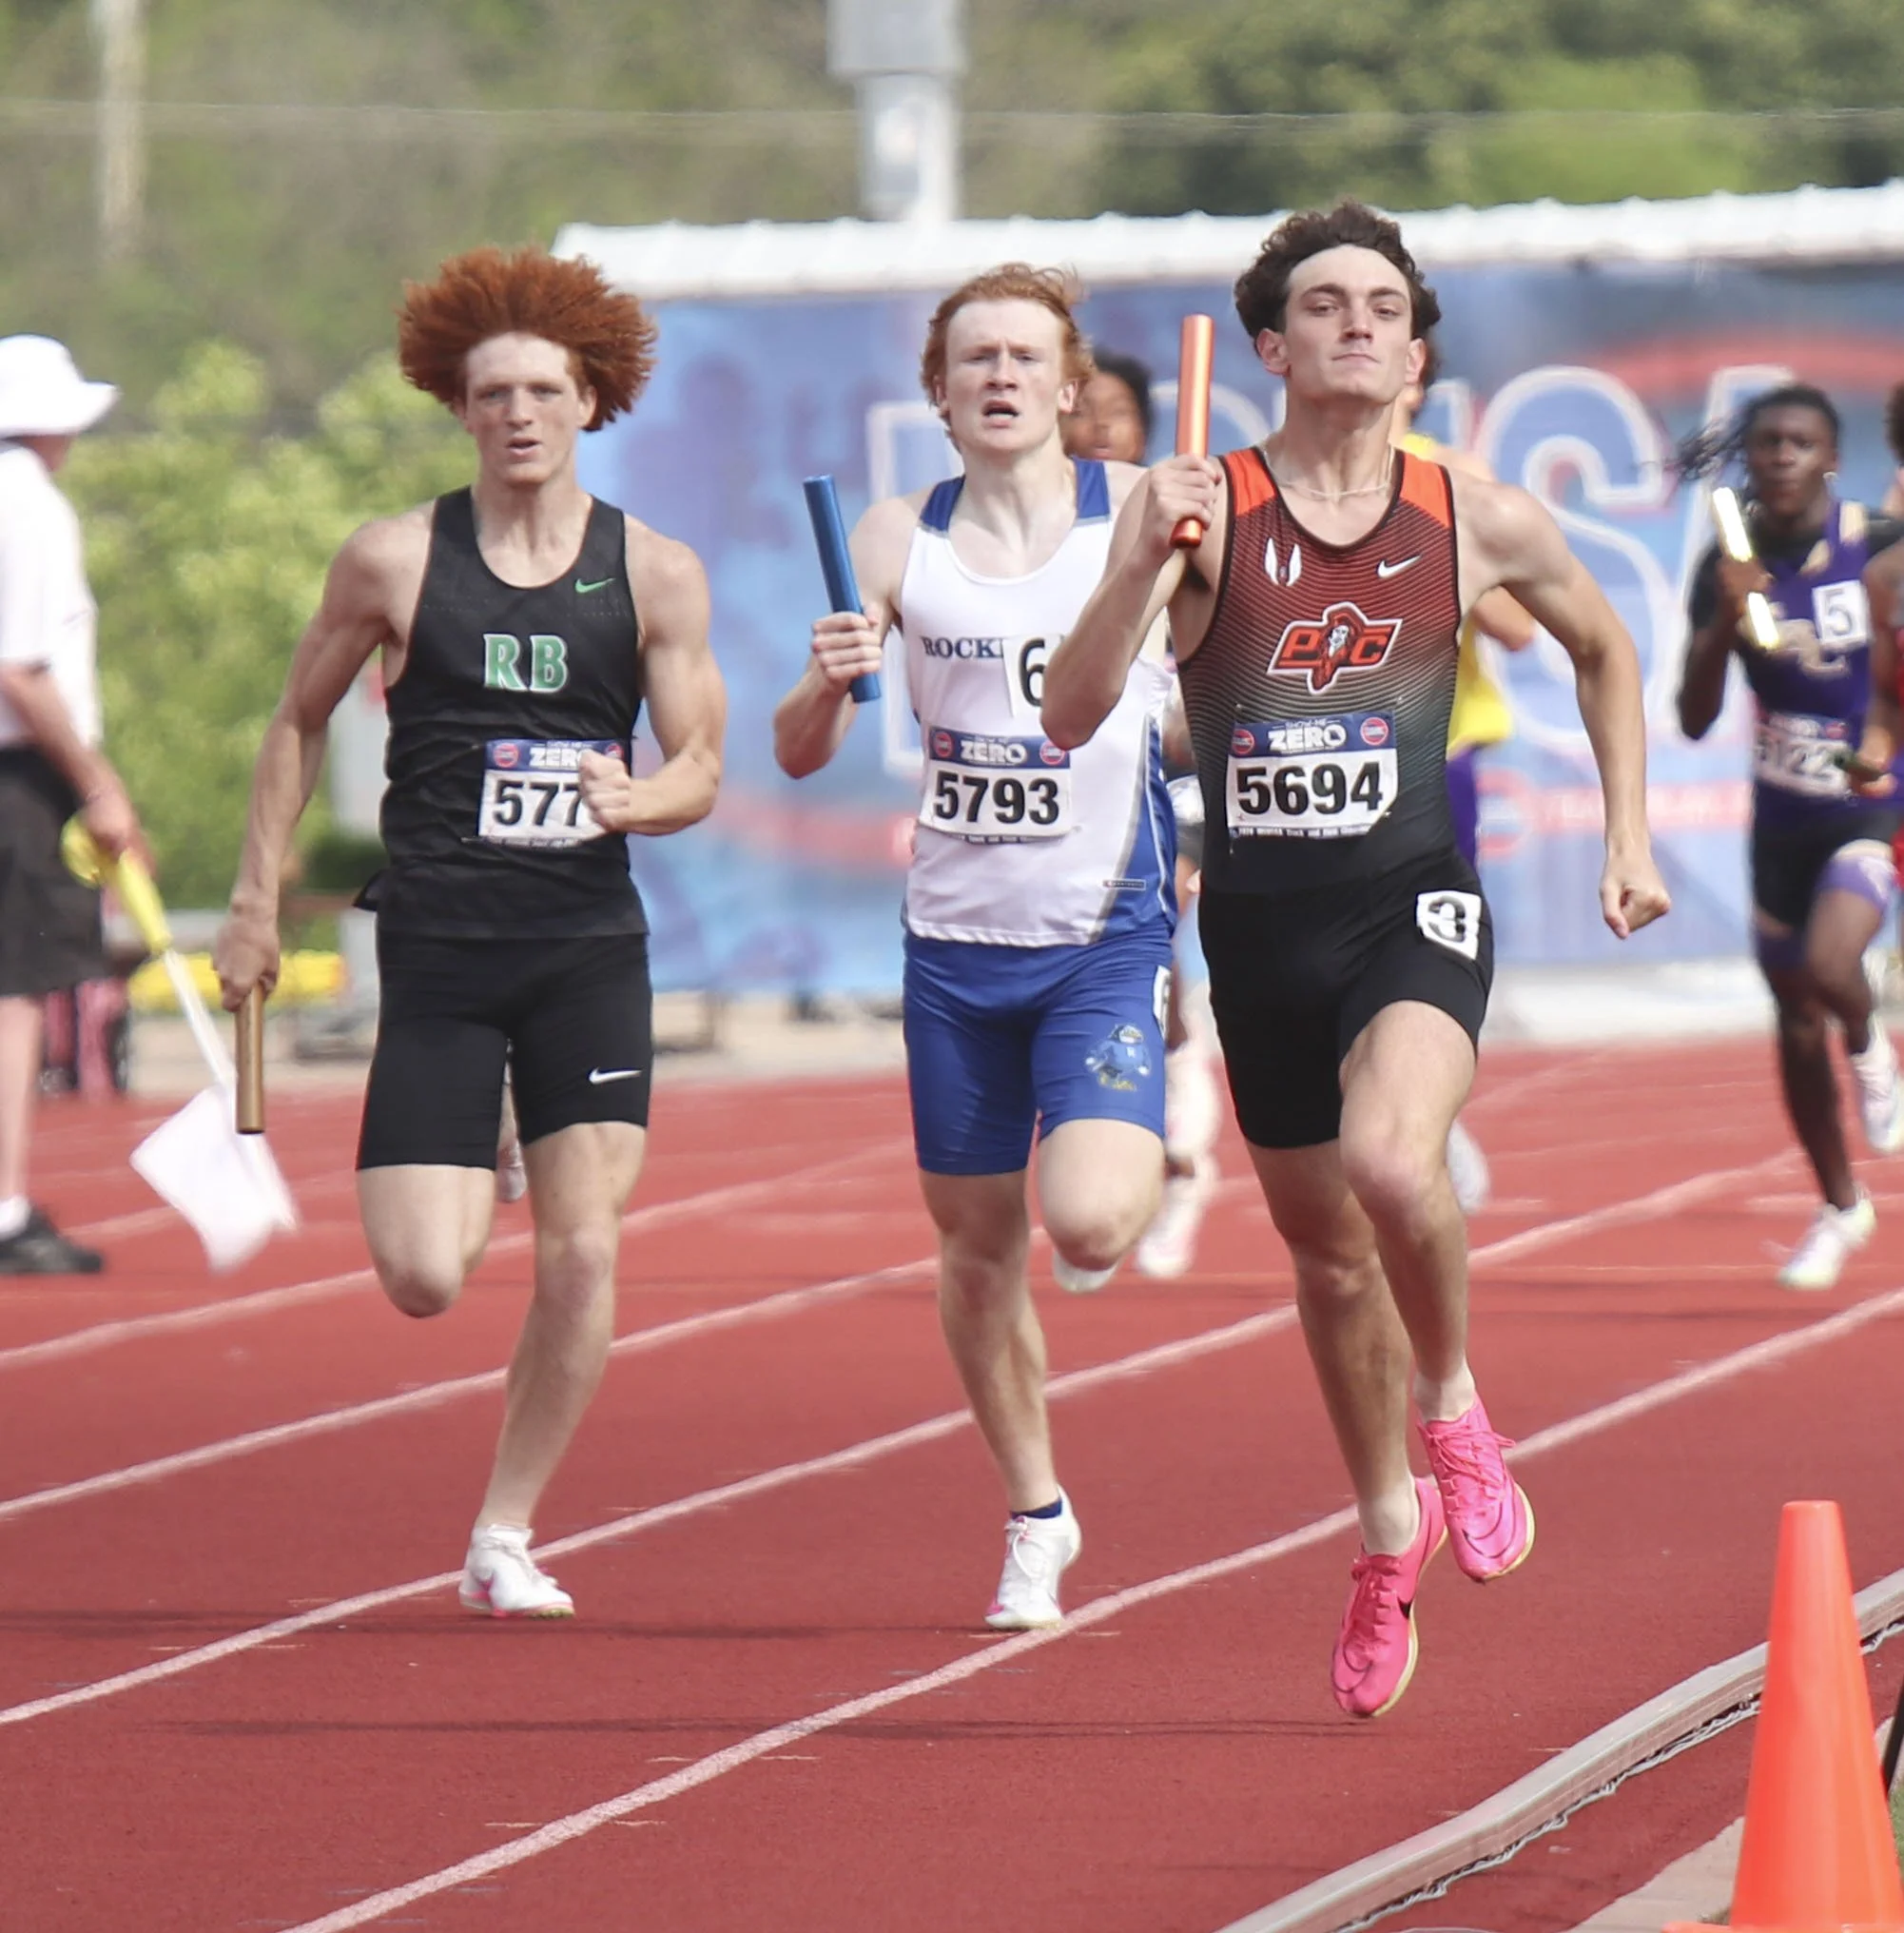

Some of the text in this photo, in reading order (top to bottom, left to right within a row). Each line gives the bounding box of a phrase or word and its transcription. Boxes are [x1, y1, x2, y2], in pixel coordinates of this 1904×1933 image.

[1825, 589, 1854, 636] 5
[483, 634, 569, 693] RB
[921, 636, 1004, 659] ROCK
[1019, 639, 1045, 707] 6
[530, 747, 586, 768] ZER
[961, 739, 1027, 765] ZERO
[1268, 724, 1348, 752] ZERO
[494, 780, 583, 828] 577
[933, 771, 1059, 825] 5793
[1237, 761, 1384, 816] 5694
[1428, 895, 1467, 943] 3
